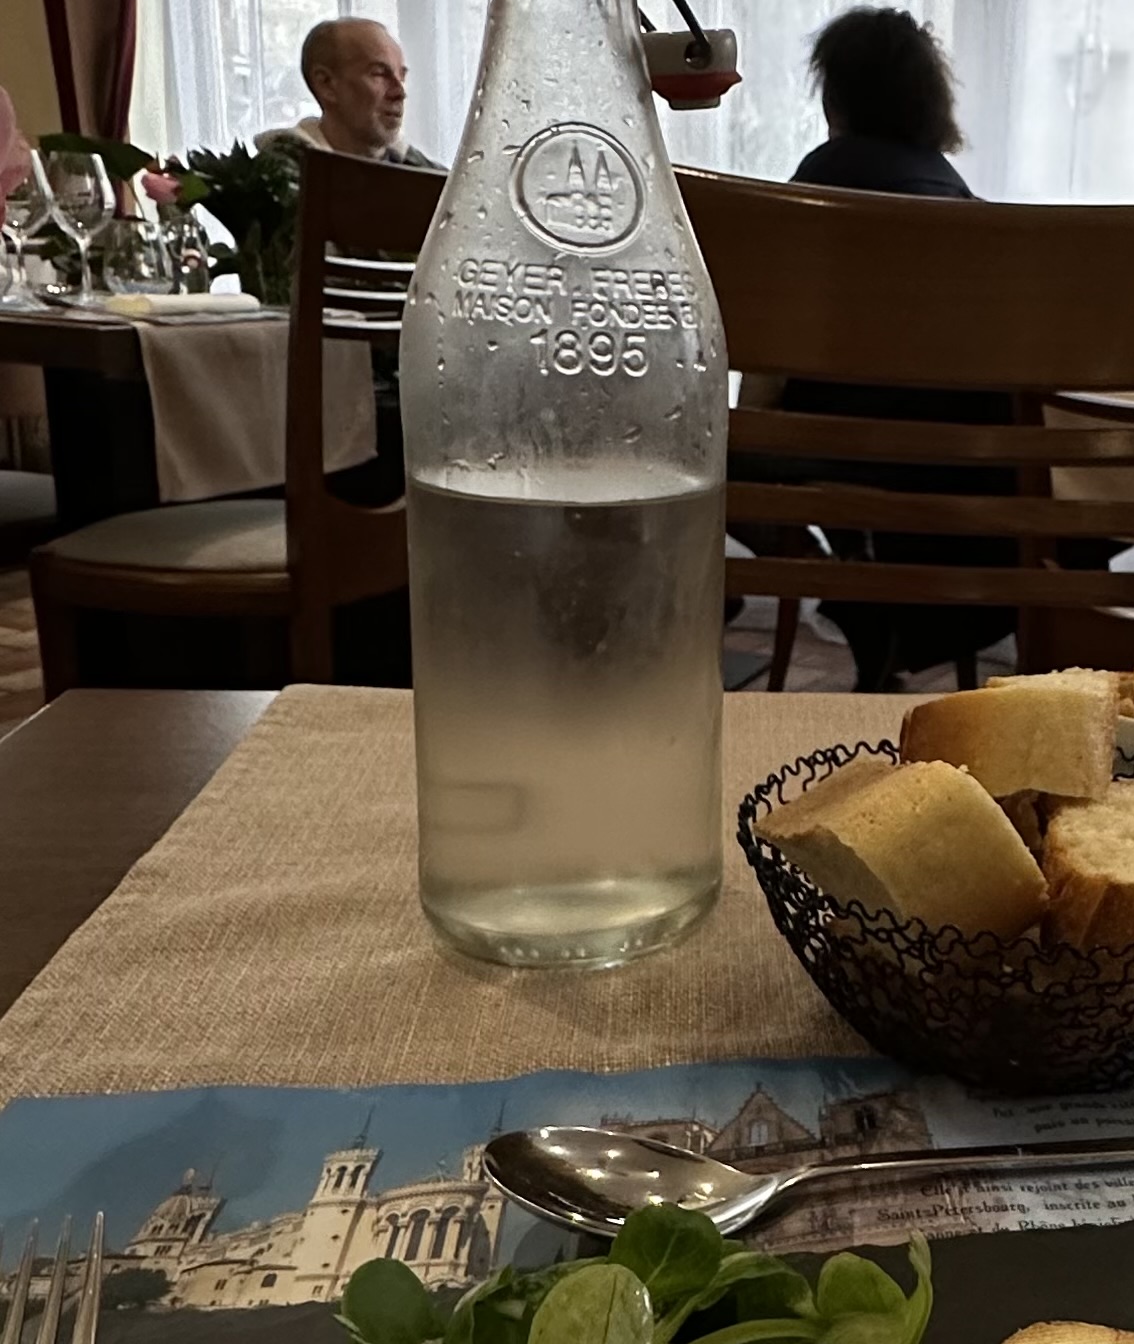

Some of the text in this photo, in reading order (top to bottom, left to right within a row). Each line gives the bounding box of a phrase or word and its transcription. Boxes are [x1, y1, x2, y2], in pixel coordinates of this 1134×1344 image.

[457, 258, 568, 297] GEYER
[452, 289, 553, 325] MAISON
[529, 328, 648, 378] 1895
[1019, 1181, 1069, 1195] rejoint
[1074, 1178, 1100, 1191] des
[1044, 1198, 1101, 1211] inscrite
[1107, 1199, 1127, 1209] au
